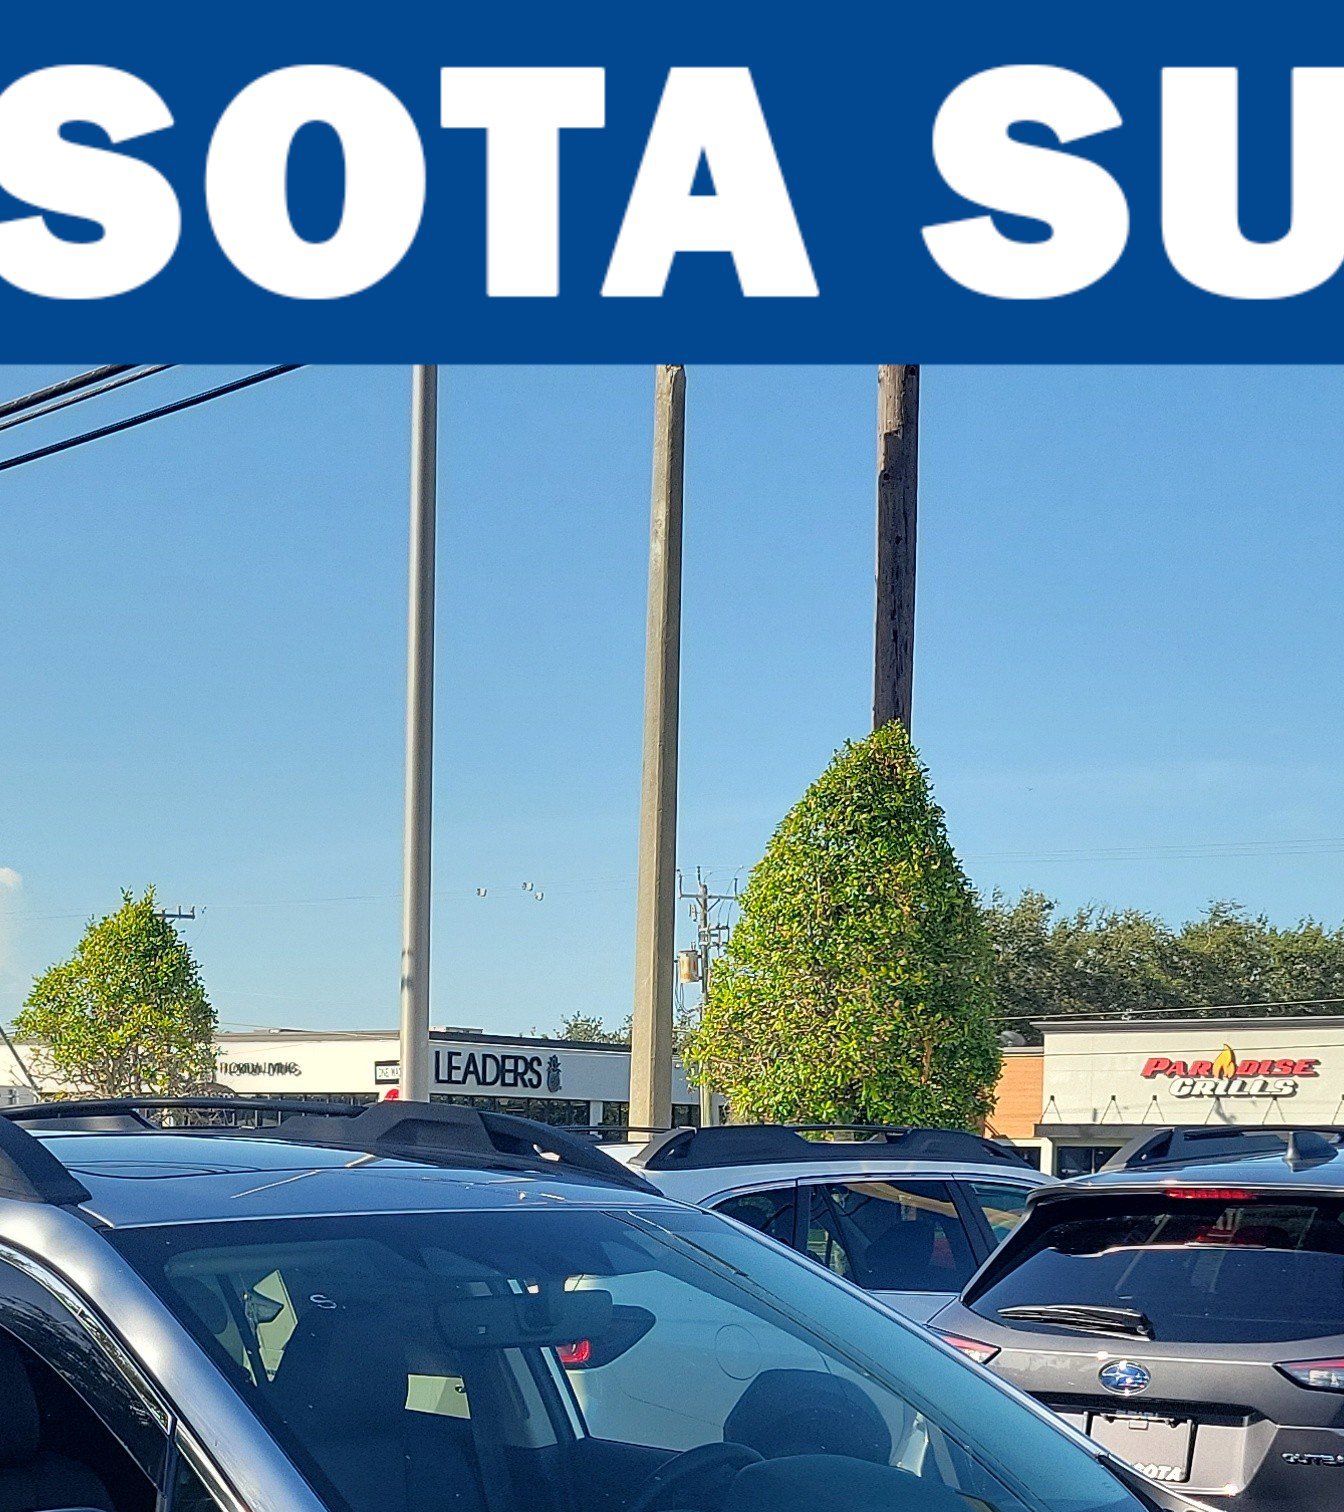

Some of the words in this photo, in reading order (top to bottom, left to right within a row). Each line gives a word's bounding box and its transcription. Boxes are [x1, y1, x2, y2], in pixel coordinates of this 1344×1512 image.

[435, 1051, 542, 1089] LEADERS
[1141, 1051, 1320, 1079] PARADISE
[1169, 1078, 1299, 1098] GRILLS
